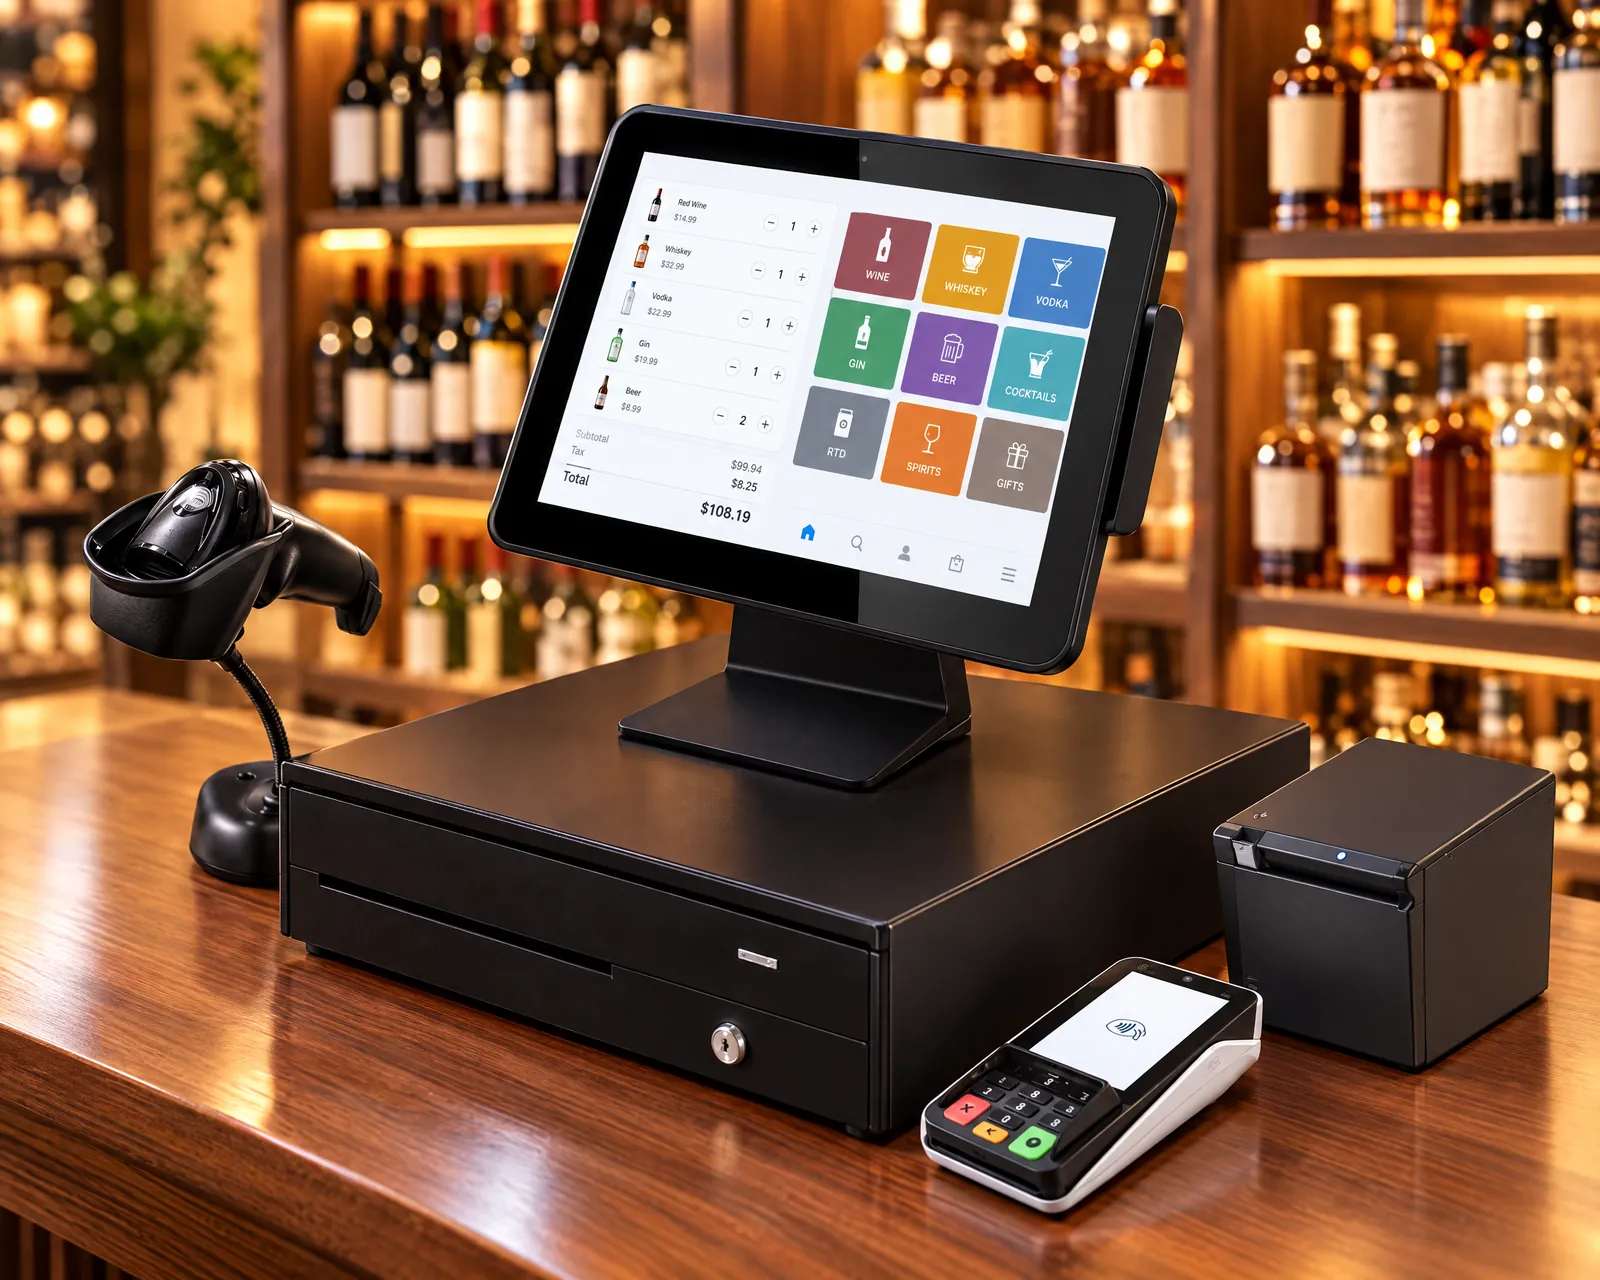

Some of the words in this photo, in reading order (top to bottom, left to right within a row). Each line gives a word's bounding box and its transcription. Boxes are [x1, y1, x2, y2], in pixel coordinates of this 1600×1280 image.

[678, 198, 690, 207] Red
[691, 200, 708, 210] Wine
[674, 214, 697, 223] $14.99
[791, 222, 796, 231] 1
[666, 245, 692, 257] Whiskey
[661, 260, 684, 270] $32.99
[778, 269, 783, 279] 1
[866, 270, 890, 281] WINE
[945, 281, 987, 296] WHISKEY
[653, 292, 672, 302] Vodka
[1037, 296, 1068, 308] VODKA
[648, 307, 671, 318] $22.99
[765, 318, 771, 328] 1
[639, 340, 650, 348] Gin
[634, 355, 658, 365] $19.99
[849, 359, 865, 369] GIN
[753, 367, 759, 376] 1
[932, 373, 956, 385] BEER
[626, 387, 641, 396] Beer
[1005, 386, 1056, 403] COCKTAILS
[621, 402, 641, 413] $8.99
[740, 416, 746, 425] 2
[576, 429, 609, 444] Subtotal
[571, 445, 585, 457] Tax
[827, 447, 846, 458] RTD
[731, 460, 762, 474] $99.94
[907, 462, 941, 476] SPIRITS
[563, 470, 589, 486] Total
[731, 478, 757, 492] $8.25
[997, 479, 1024, 491] GIFTS
[701, 501, 750, 523] $108.19
